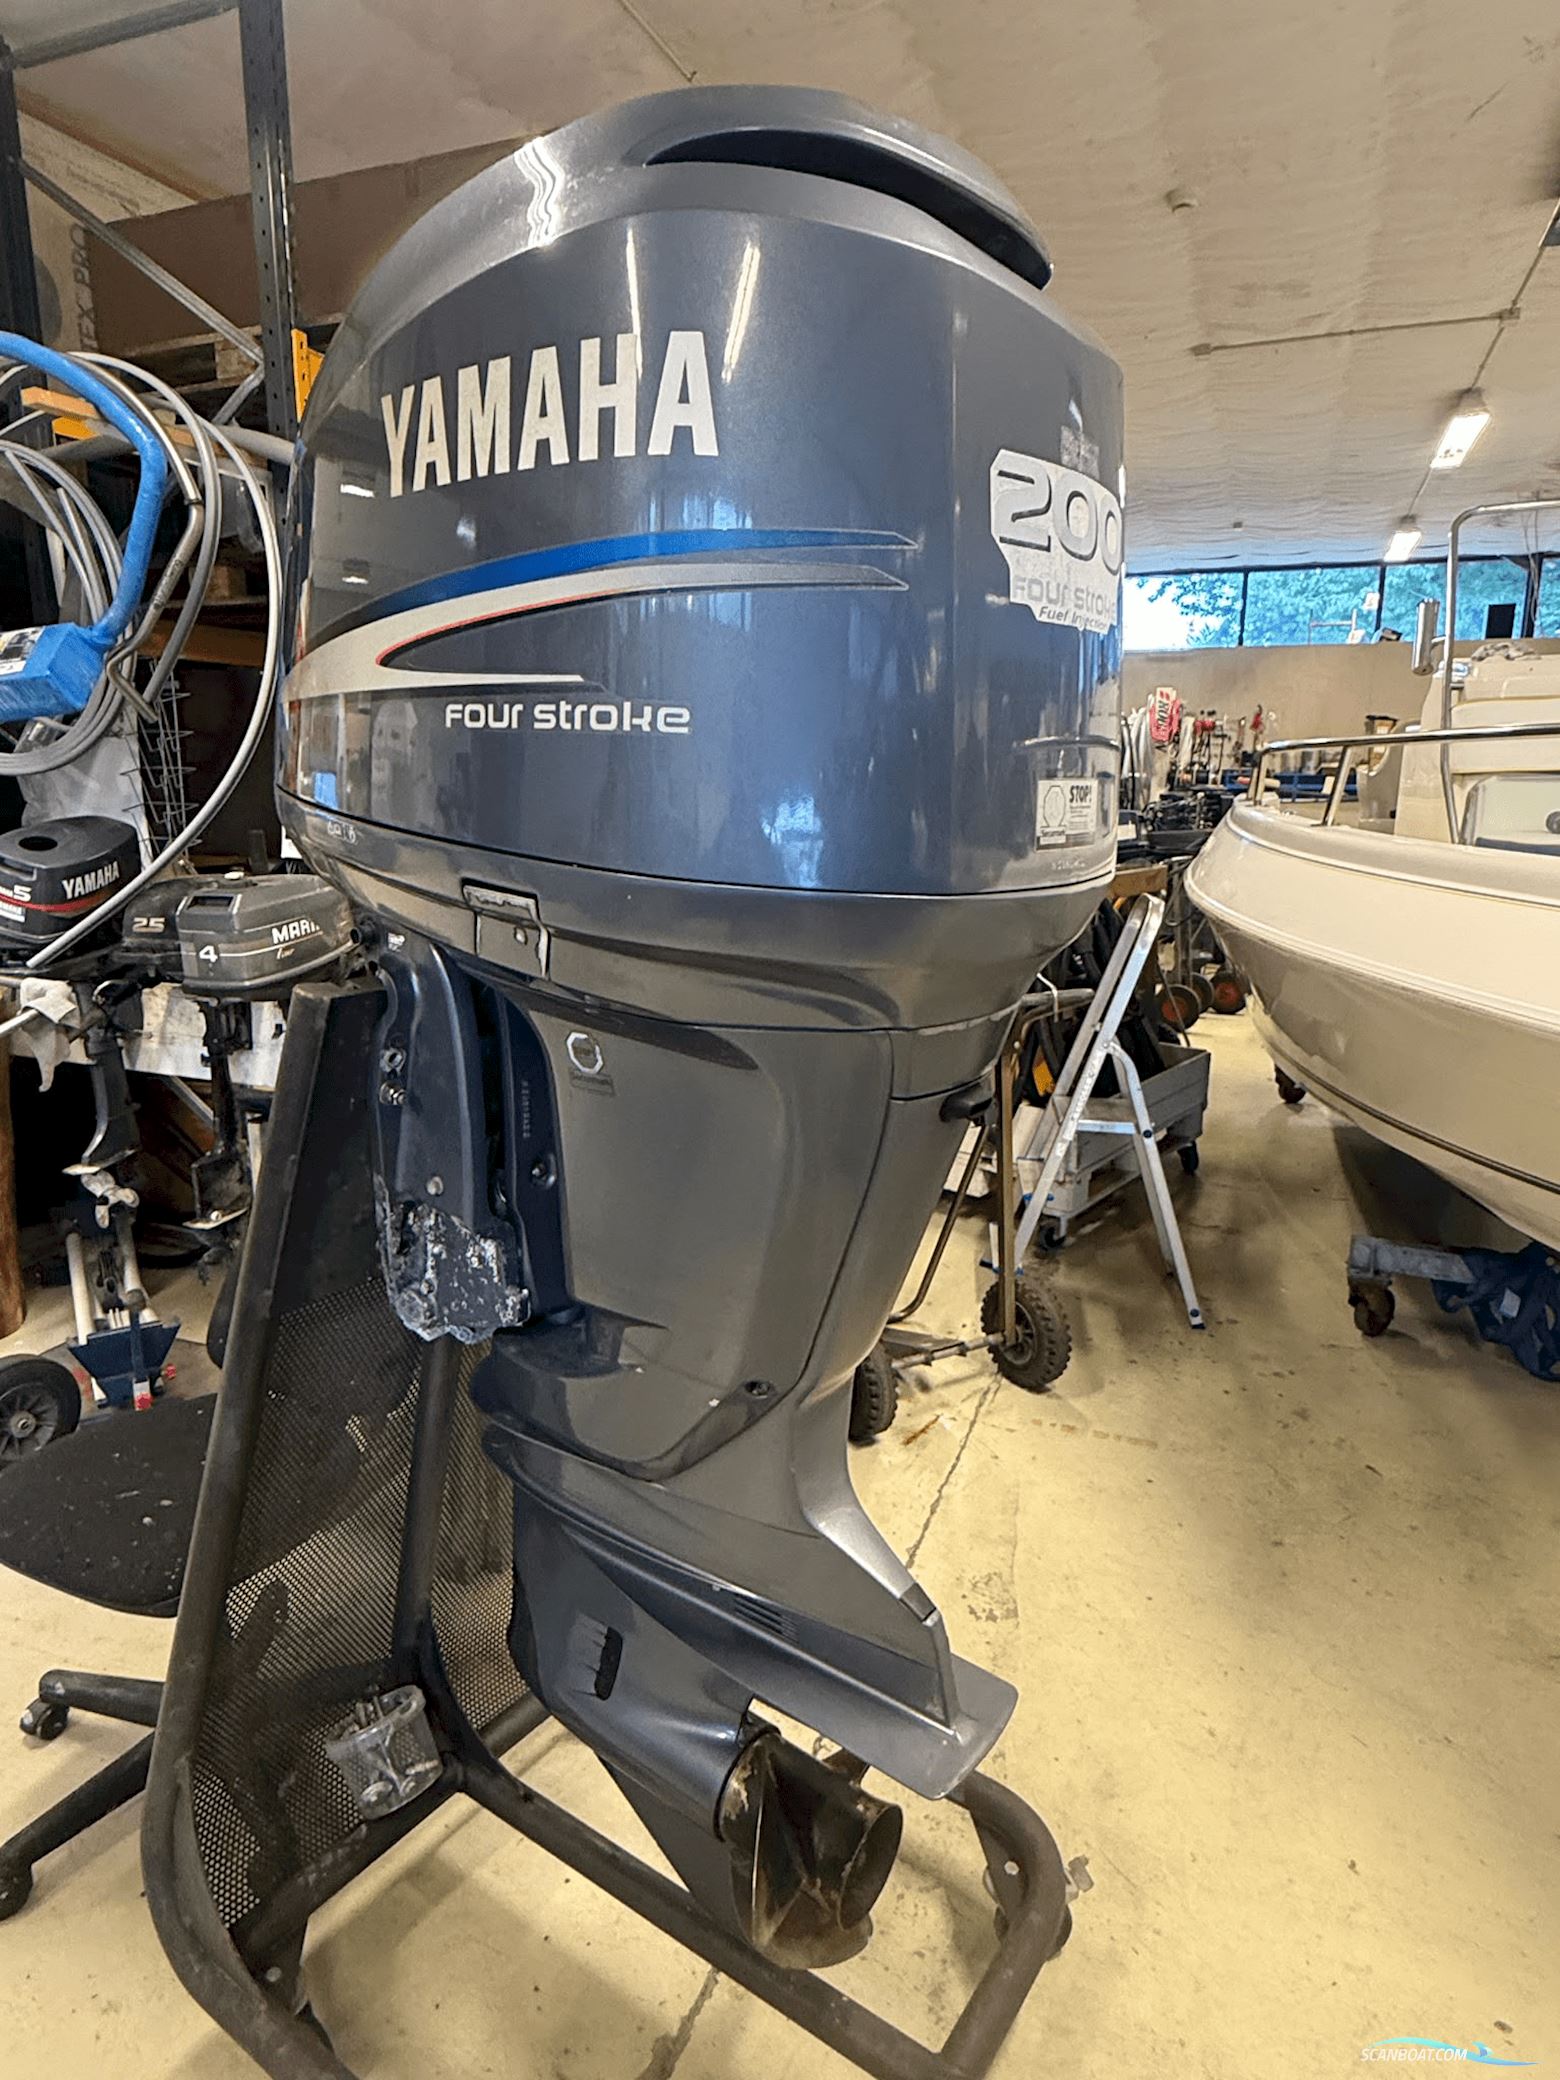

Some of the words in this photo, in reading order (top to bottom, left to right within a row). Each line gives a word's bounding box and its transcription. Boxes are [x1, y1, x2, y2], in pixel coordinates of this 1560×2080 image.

[381, 331, 719, 498] YAMAHA
[993, 451, 1121, 576] 200
[1039, 606, 1069, 622] Fuel
[1069, 785, 1092, 803] STOP!
[62, 861, 120, 900] YAMAHA
[132, 917, 166, 933] 25
[199, 945, 218, 963] 4
